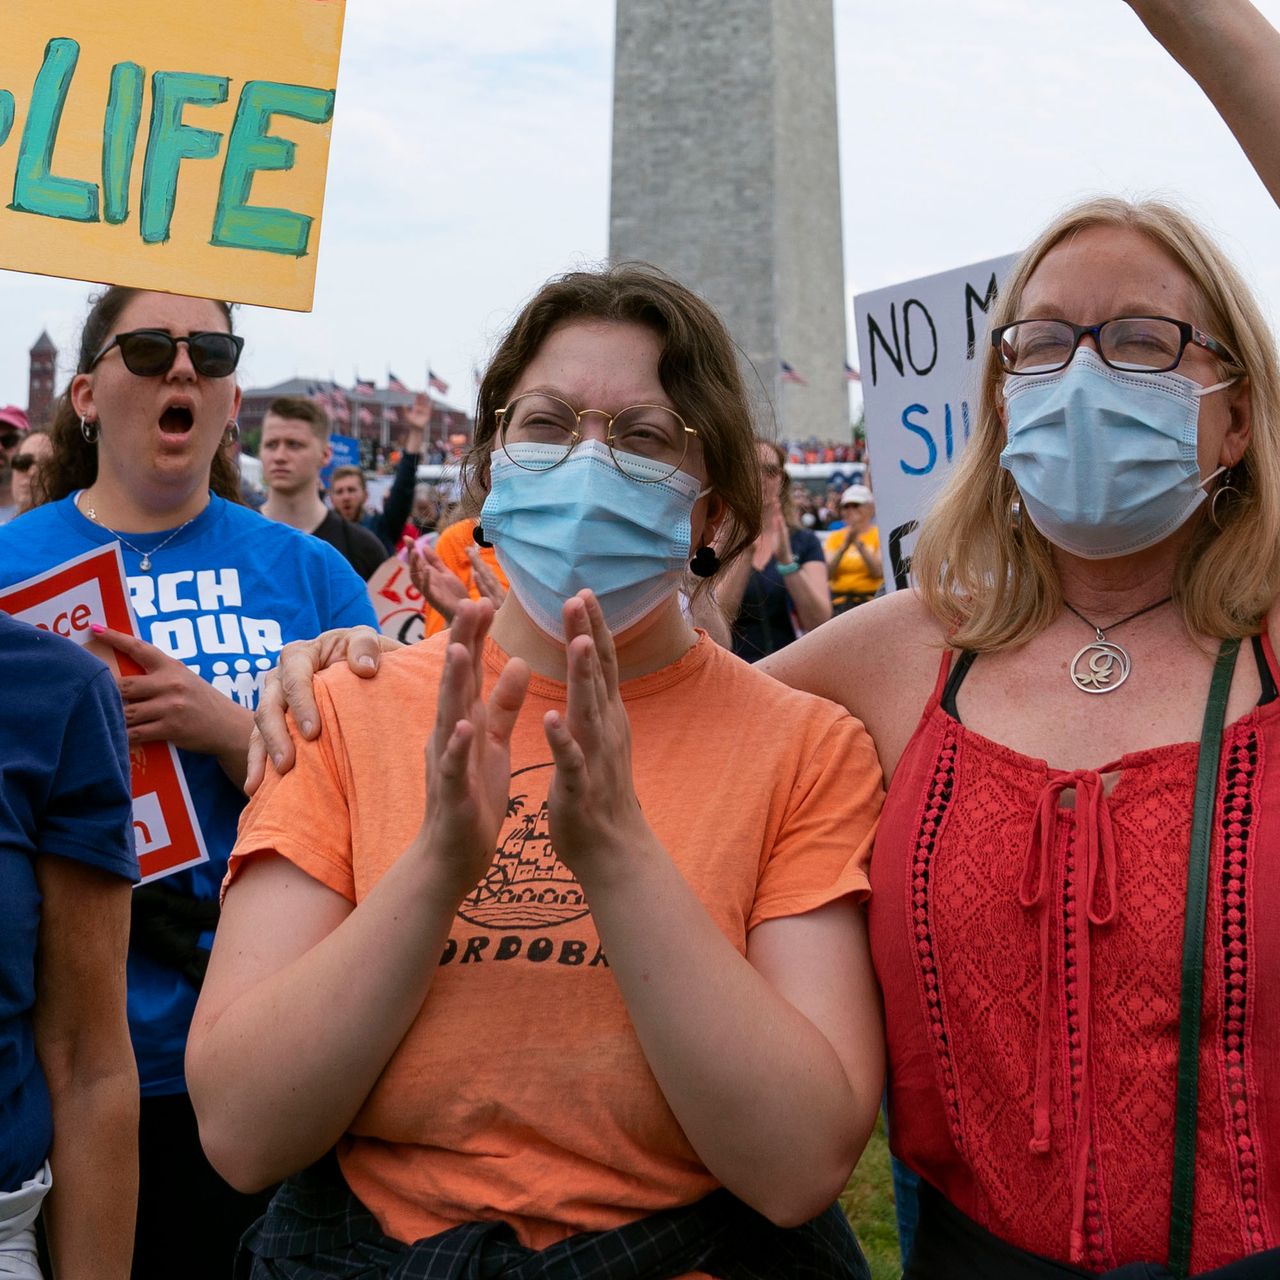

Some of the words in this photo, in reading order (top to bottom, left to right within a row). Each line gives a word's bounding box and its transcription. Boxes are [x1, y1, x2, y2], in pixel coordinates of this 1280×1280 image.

[5, 36, 337, 258] LIFE
[867, 298, 938, 387] NO
[126, 568, 243, 618] RCH
[150, 614, 284, 660] OUR
[438, 935, 611, 968] ORDOBA
